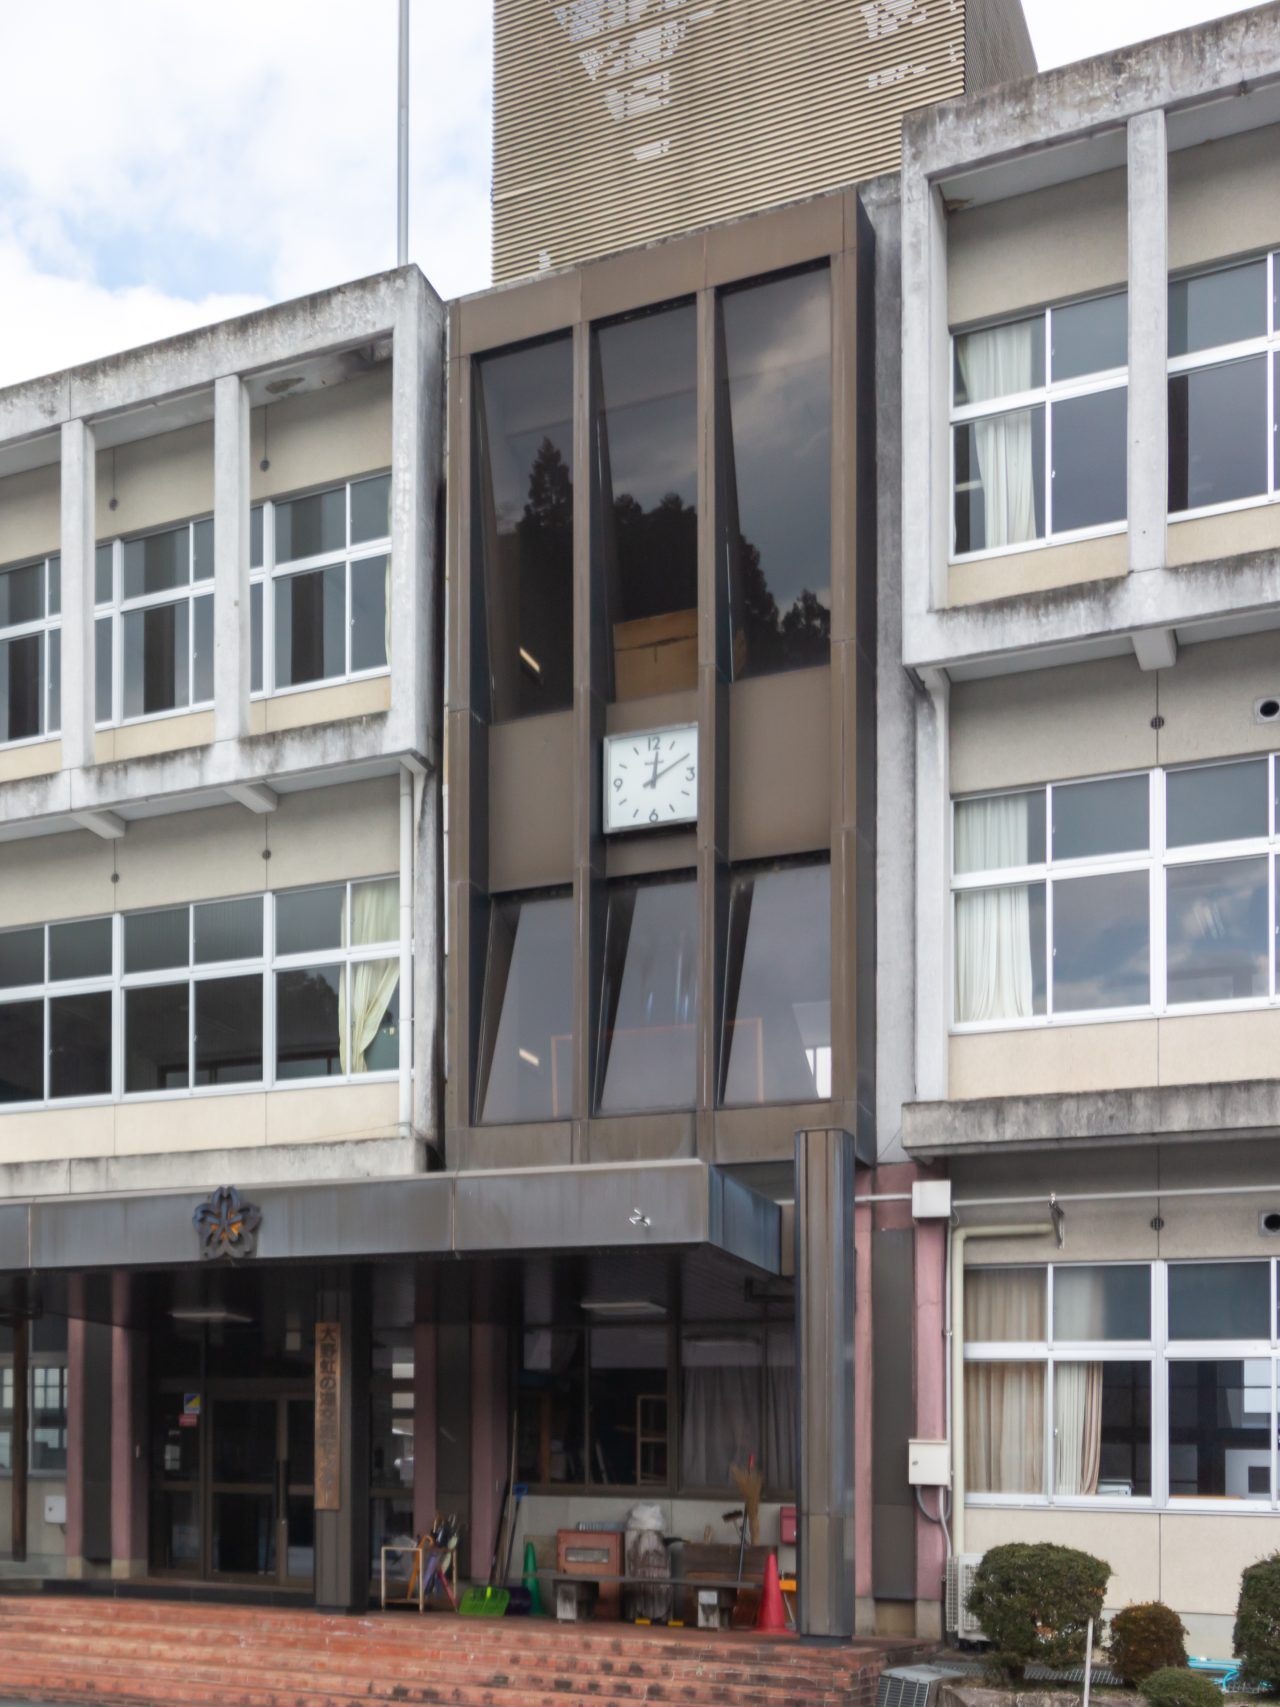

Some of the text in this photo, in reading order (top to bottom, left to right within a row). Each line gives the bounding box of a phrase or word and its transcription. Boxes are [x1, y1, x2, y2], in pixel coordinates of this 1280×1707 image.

[647, 736, 661, 751] 12
[685, 766, 696, 782] 3
[613, 778, 624, 792] 9
[648, 808, 659, 823] 6
